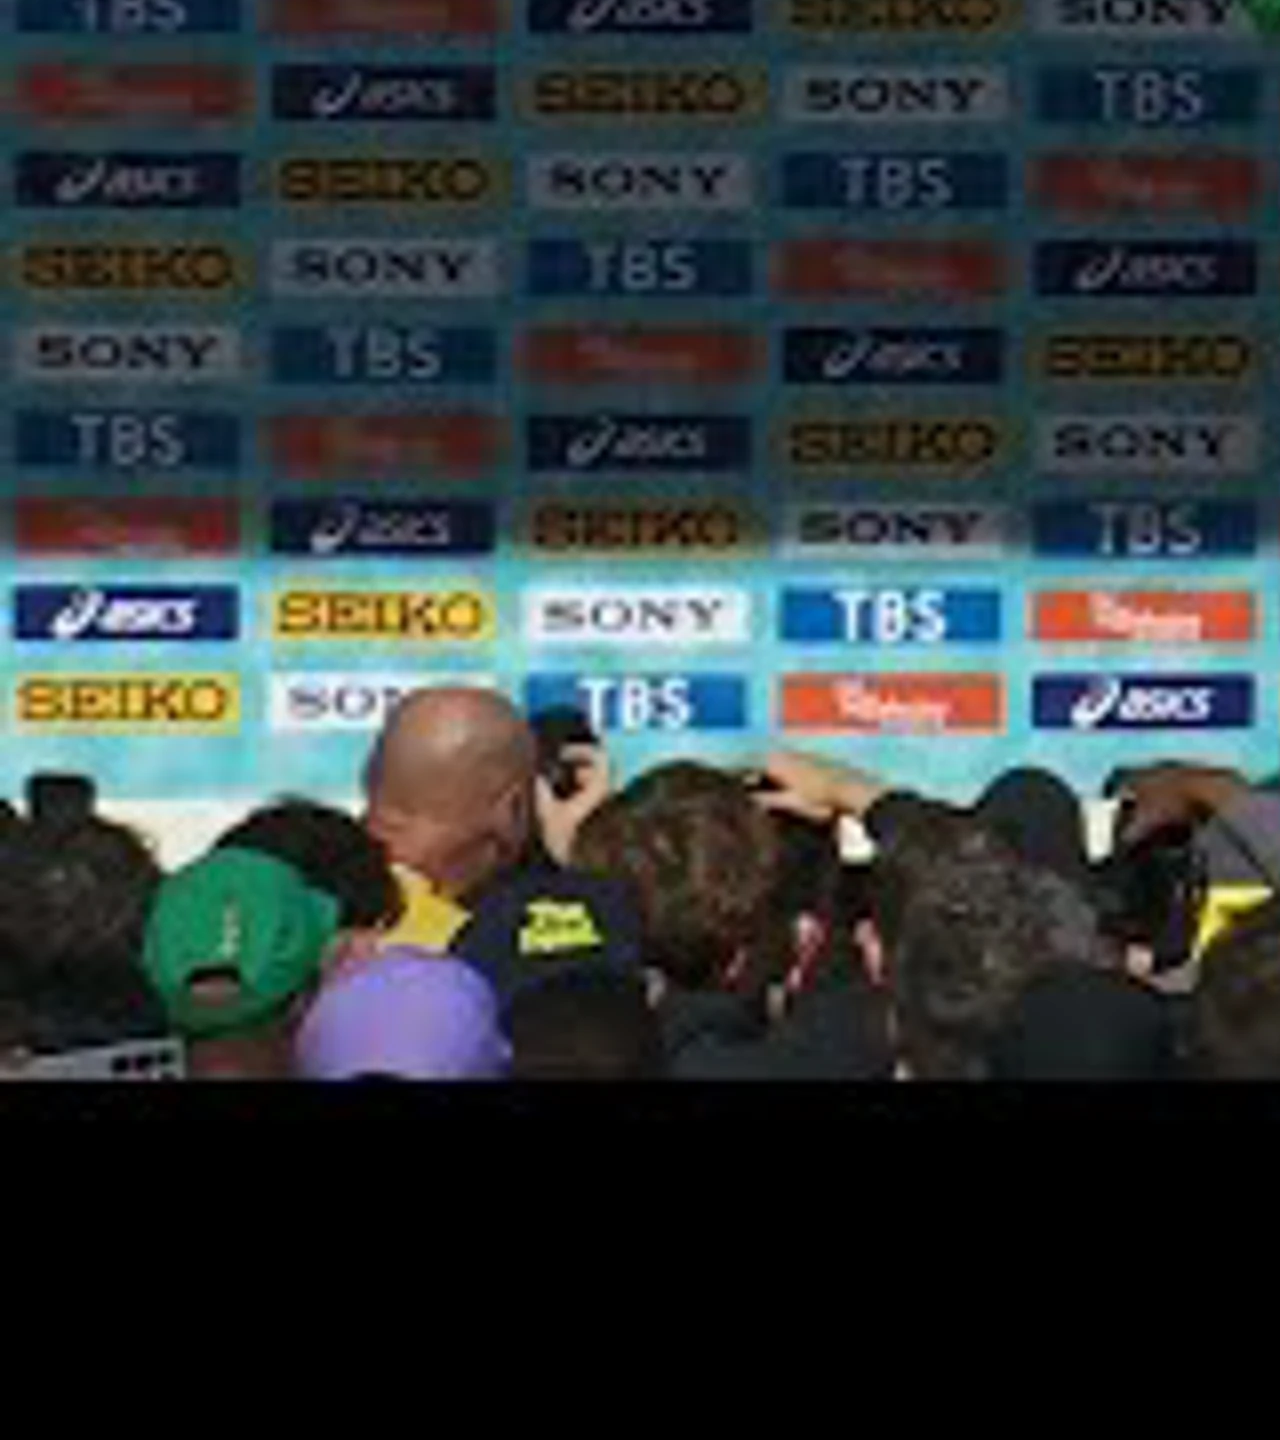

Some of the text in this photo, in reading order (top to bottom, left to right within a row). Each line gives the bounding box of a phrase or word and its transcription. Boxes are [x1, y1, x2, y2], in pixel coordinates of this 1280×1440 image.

[536, 71, 743, 114] SEIKO
[803, 76, 982, 110] SONY
[1091, 71, 1208, 121] TBS
[280, 158, 487, 201] SEIKO
[548, 163, 727, 197] SONY
[837, 157, 954, 207] TBS
[24, 245, 231, 288] SEIKO
[292, 249, 471, 283] SONY
[582, 243, 699, 293] TBS
[36, 334, 215, 368] SONY
[326, 330, 443, 380] TBS
[1042, 334, 1249, 377] SEIKO
[70, 415, 187, 465] TBS
[789, 420, 996, 463] SEIKO
[1054, 424, 1233, 458] SONY
[534, 505, 741, 548] SEIKO
[803, 509, 982, 543] SONY
[1087, 502, 1204, 552] TBS
[277, 592, 484, 635] SEIKO
[544, 598, 723, 632] SONY
[833, 590, 950, 640] TBS
[21, 678, 228, 721] SEIKO
